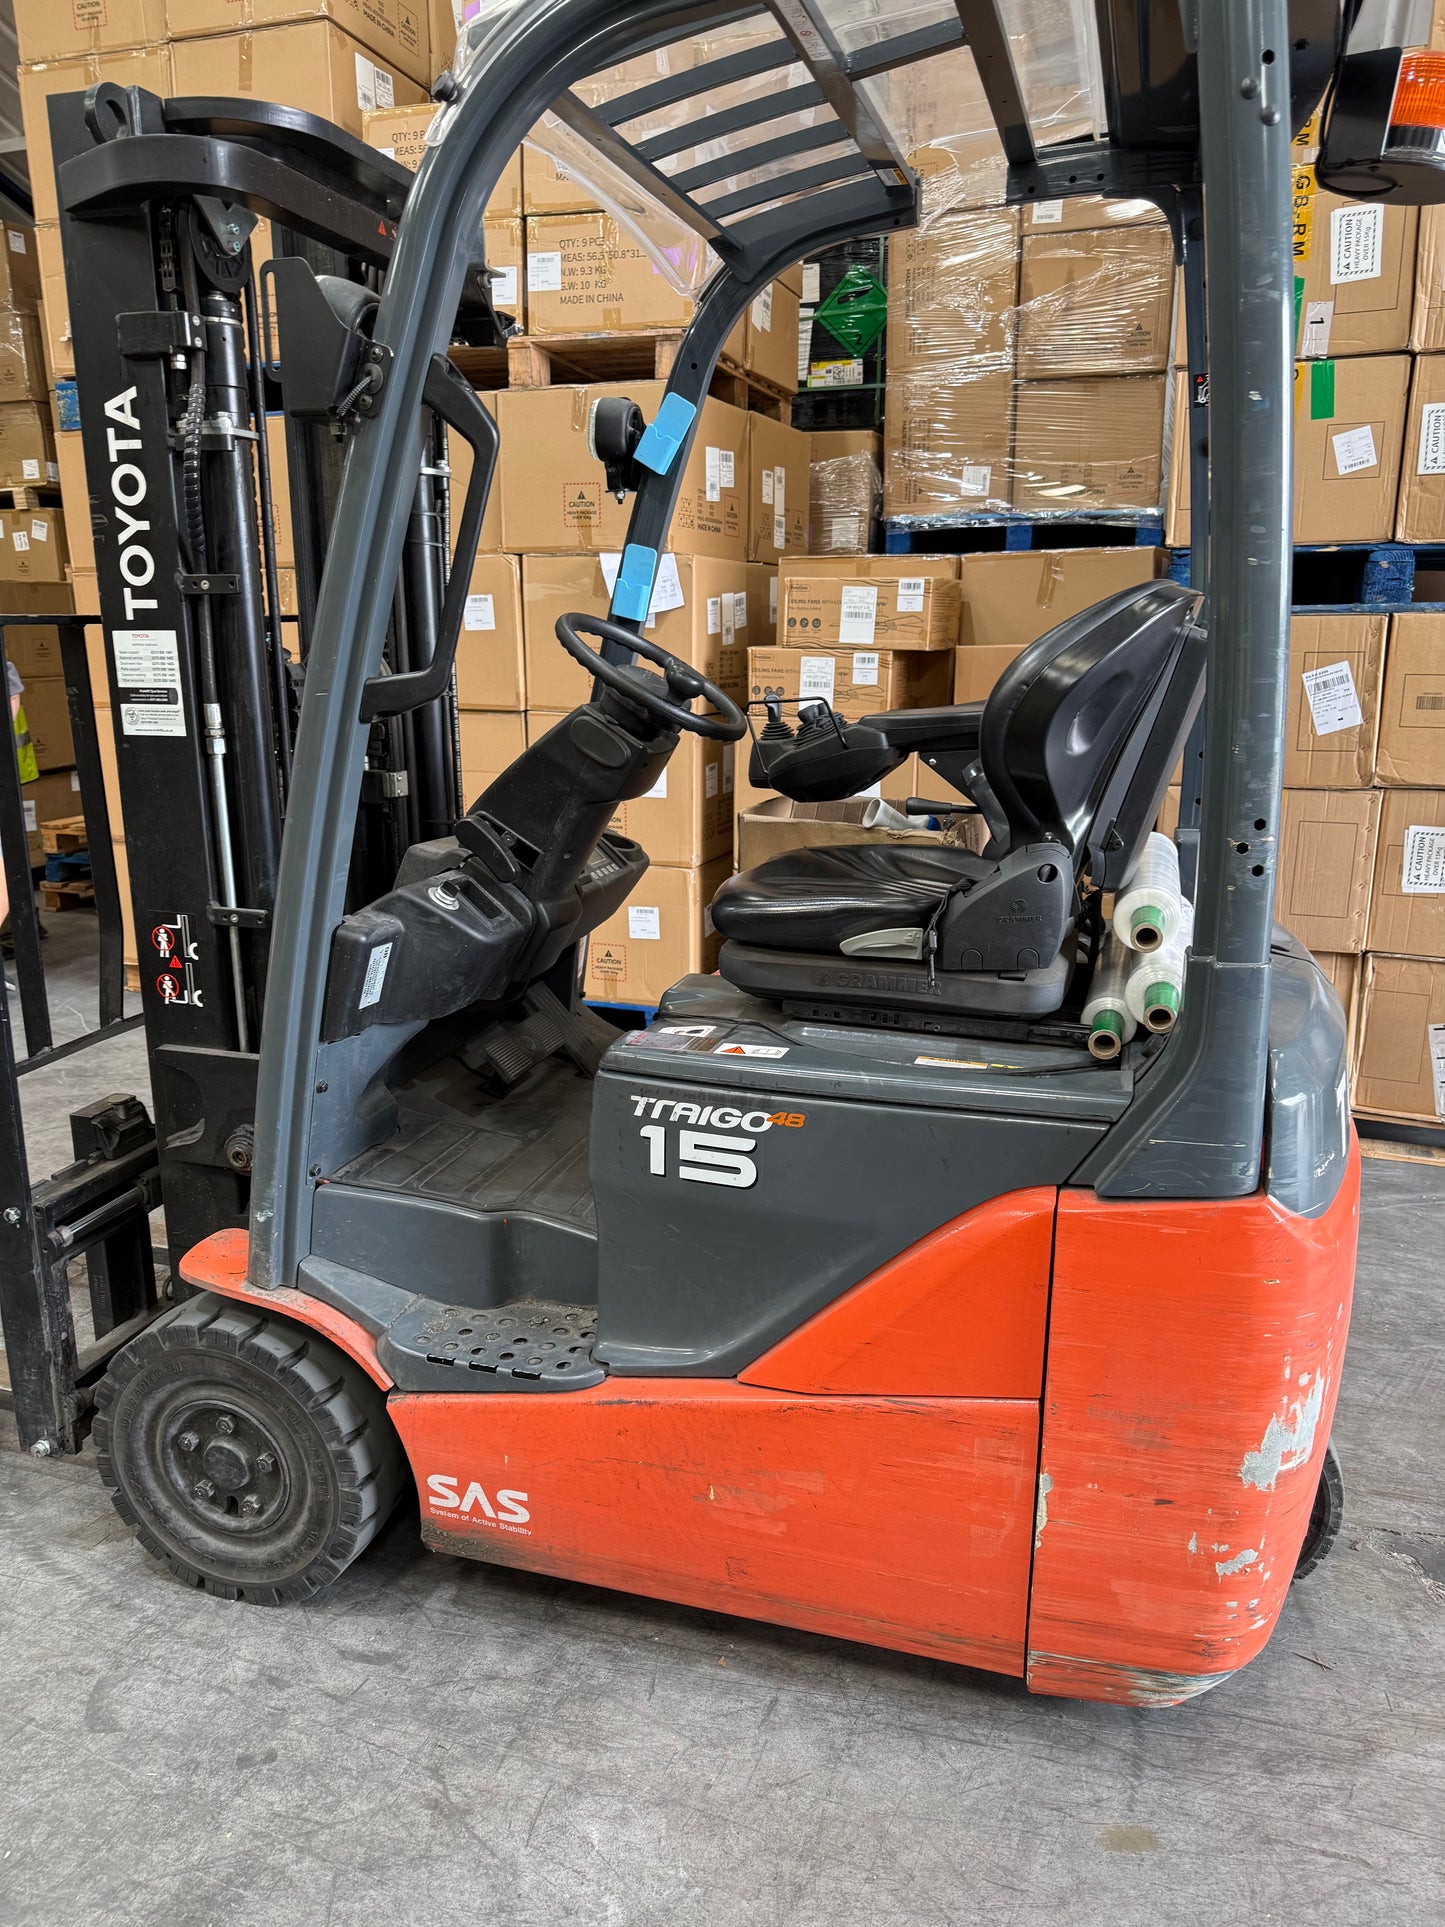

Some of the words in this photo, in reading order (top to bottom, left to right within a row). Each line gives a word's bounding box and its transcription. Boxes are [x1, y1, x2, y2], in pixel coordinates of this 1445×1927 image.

[392, 131, 411, 143] QTY:
[413, 131, 419, 140] 9
[559, 238, 580, 250] QTY:
[582, 238, 588, 247] 9
[1344, 218, 1353, 259] CAUTION
[580, 266, 593, 276] 9.3
[580, 281, 590, 290] 10
[560, 294, 584, 305] MADE
[585, 294, 595, 304] IN
[597, 292, 624, 303] CHINA
[1310, 317, 1325, 325] 1
[1431, 415, 1441, 453] CAUTION
[104, 385, 158, 621] TOYOTA
[1414, 836, 1426, 871] CAUTION
[1427, 838, 1435, 864] PACKAGE
[838, 972, 942, 996] GRAMMER
[766, 1111, 806, 1129] 48
[639, 1124, 758, 1189] 15
[427, 1474, 531, 1524] SAS
[430, 1507, 459, 1519] System
[472, 1516, 497, 1528] Active
[499, 1522, 532, 1537] Stability
